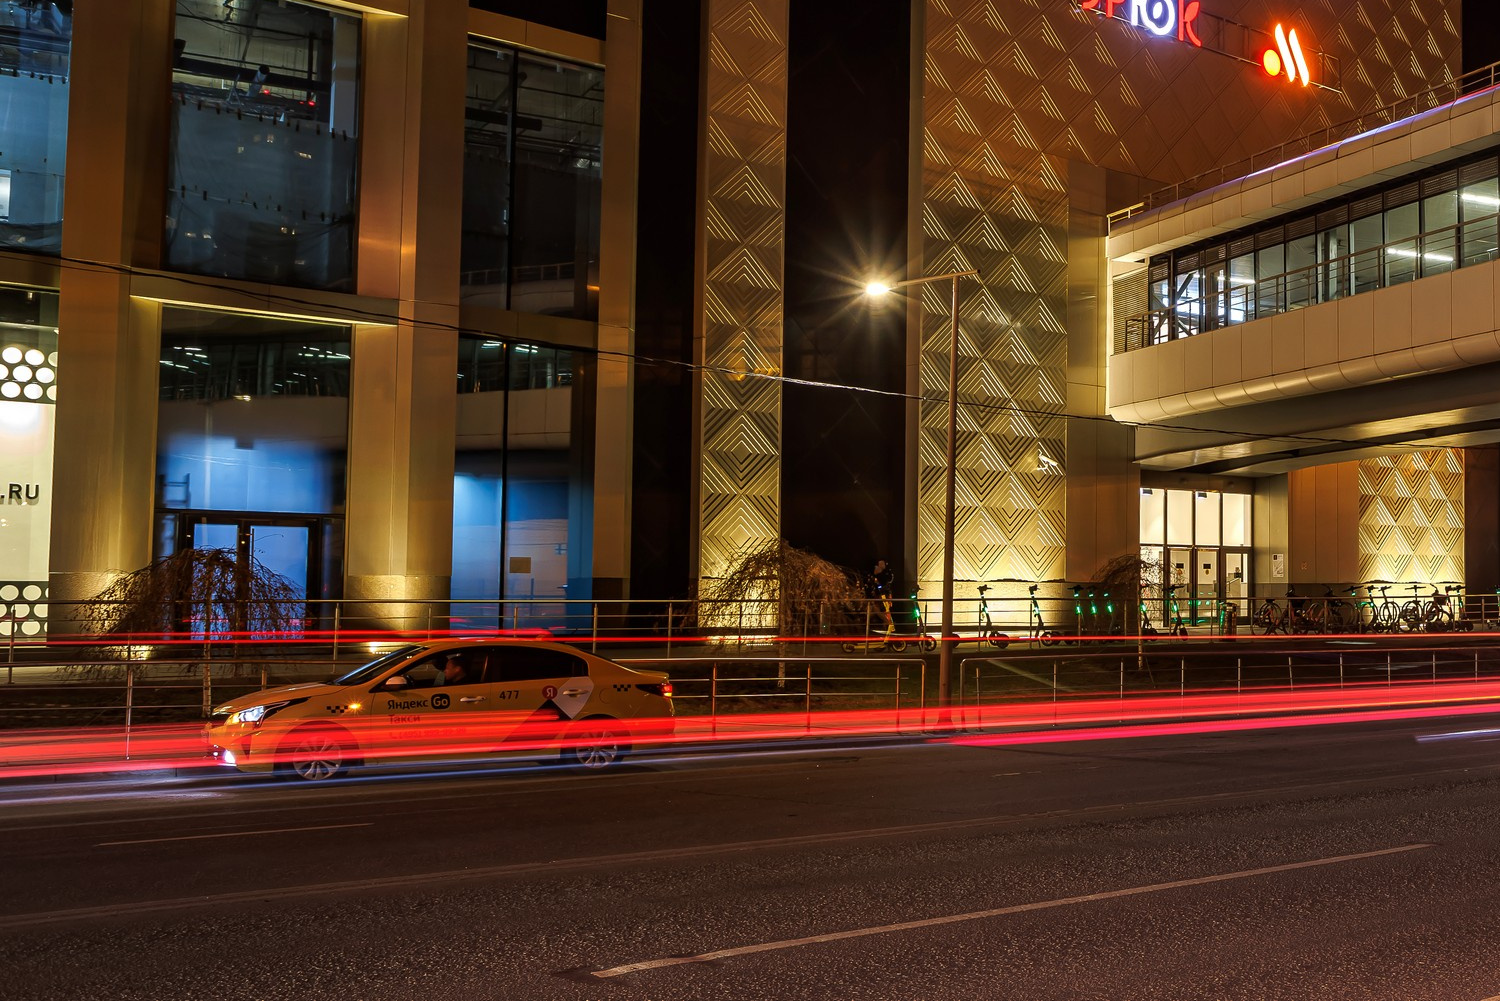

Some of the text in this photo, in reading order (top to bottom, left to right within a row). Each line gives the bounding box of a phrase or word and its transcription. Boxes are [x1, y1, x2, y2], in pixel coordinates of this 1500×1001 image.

[499, 690, 519, 700] 477
[387, 697, 449, 710] Яндекс Go
[388, 713, 421, 724] Такси
